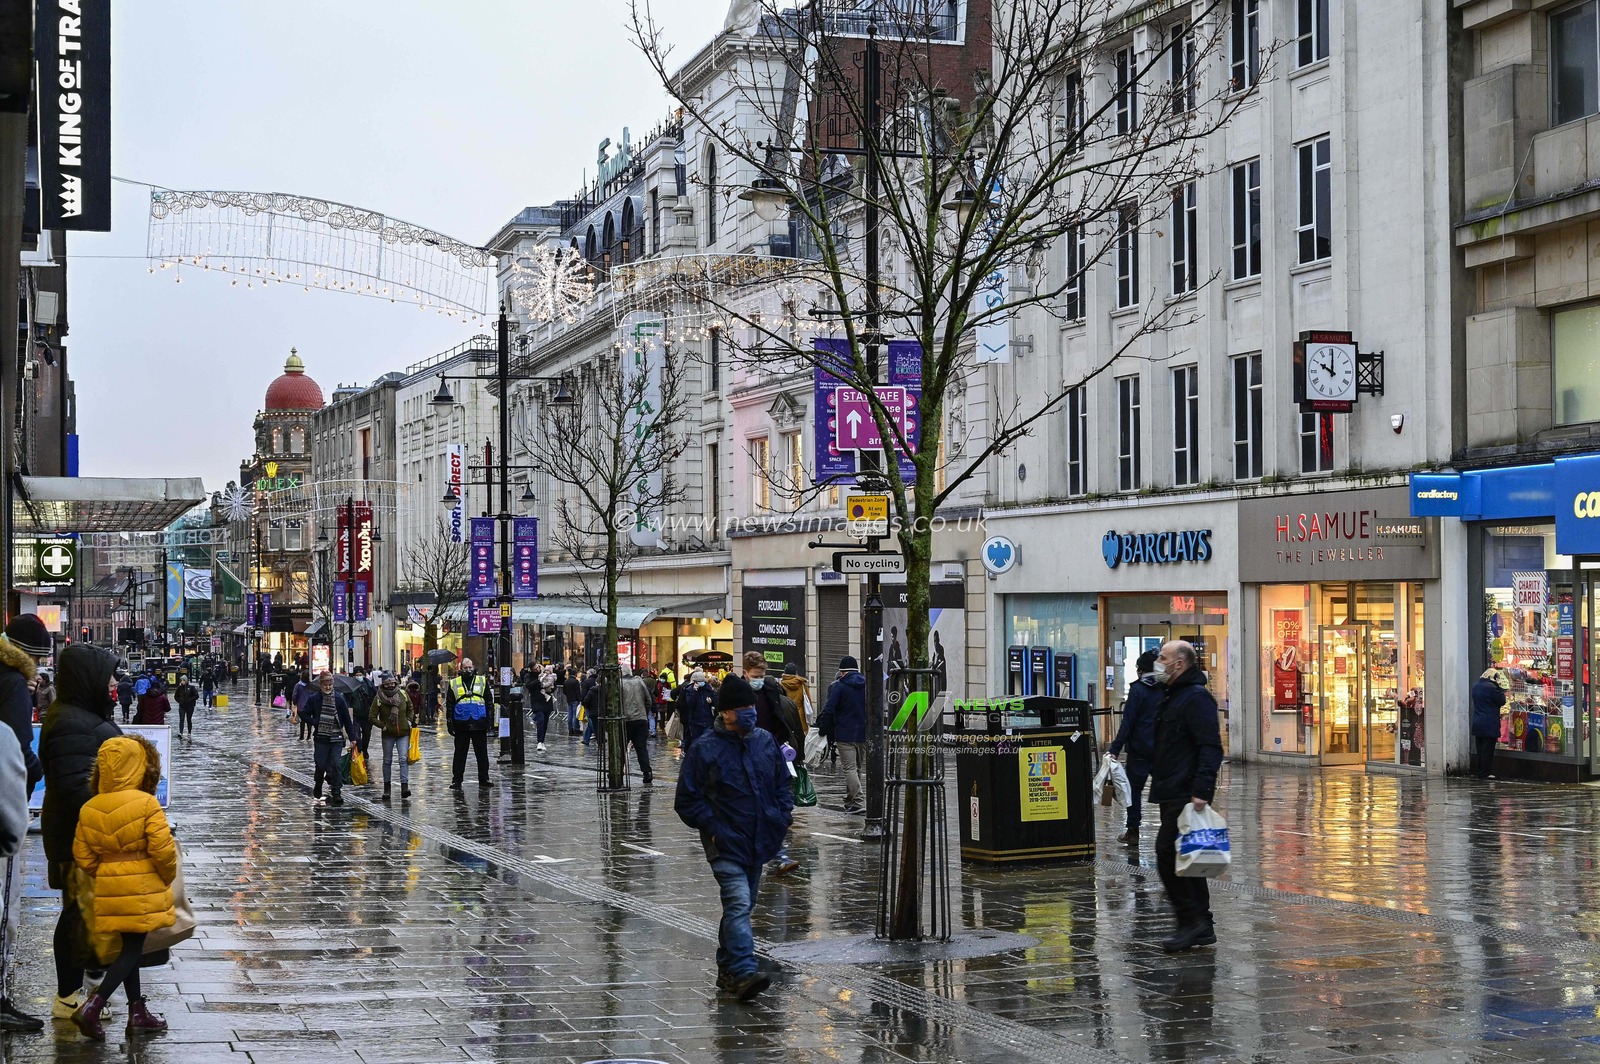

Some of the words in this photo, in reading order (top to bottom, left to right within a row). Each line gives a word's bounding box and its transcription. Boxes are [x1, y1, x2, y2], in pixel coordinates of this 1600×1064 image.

[59, 0, 82, 55] TRA
[59, 59, 77, 89] OF
[59, 93, 82, 166] KING
[1312, 334, 1348, 342] H.SAMUEL
[868, 405, 901, 413] Pase
[1417, 489, 1458, 501] cardfactory
[1376, 524, 1423, 534] H.SAMUEL
[1122, 529, 1212, 564] BARCLAYS
[1277, 549, 1301, 563] THE
[1310, 547, 1384, 565] JEWELLER
[846, 559, 861, 568] No
[864, 558, 900, 569] cycling
[1518, 580, 1540, 590] CHARITY
[1518, 591, 1541, 604] CARDS
[759, 624, 775, 634] COMING
[776, 624, 789, 635] SOON
[1277, 621, 1299, 630] 50%
[1277, 630, 1297, 639] OFF
[1027, 752, 1057, 763] STREET
[1028, 762, 1058, 777] ZERO
